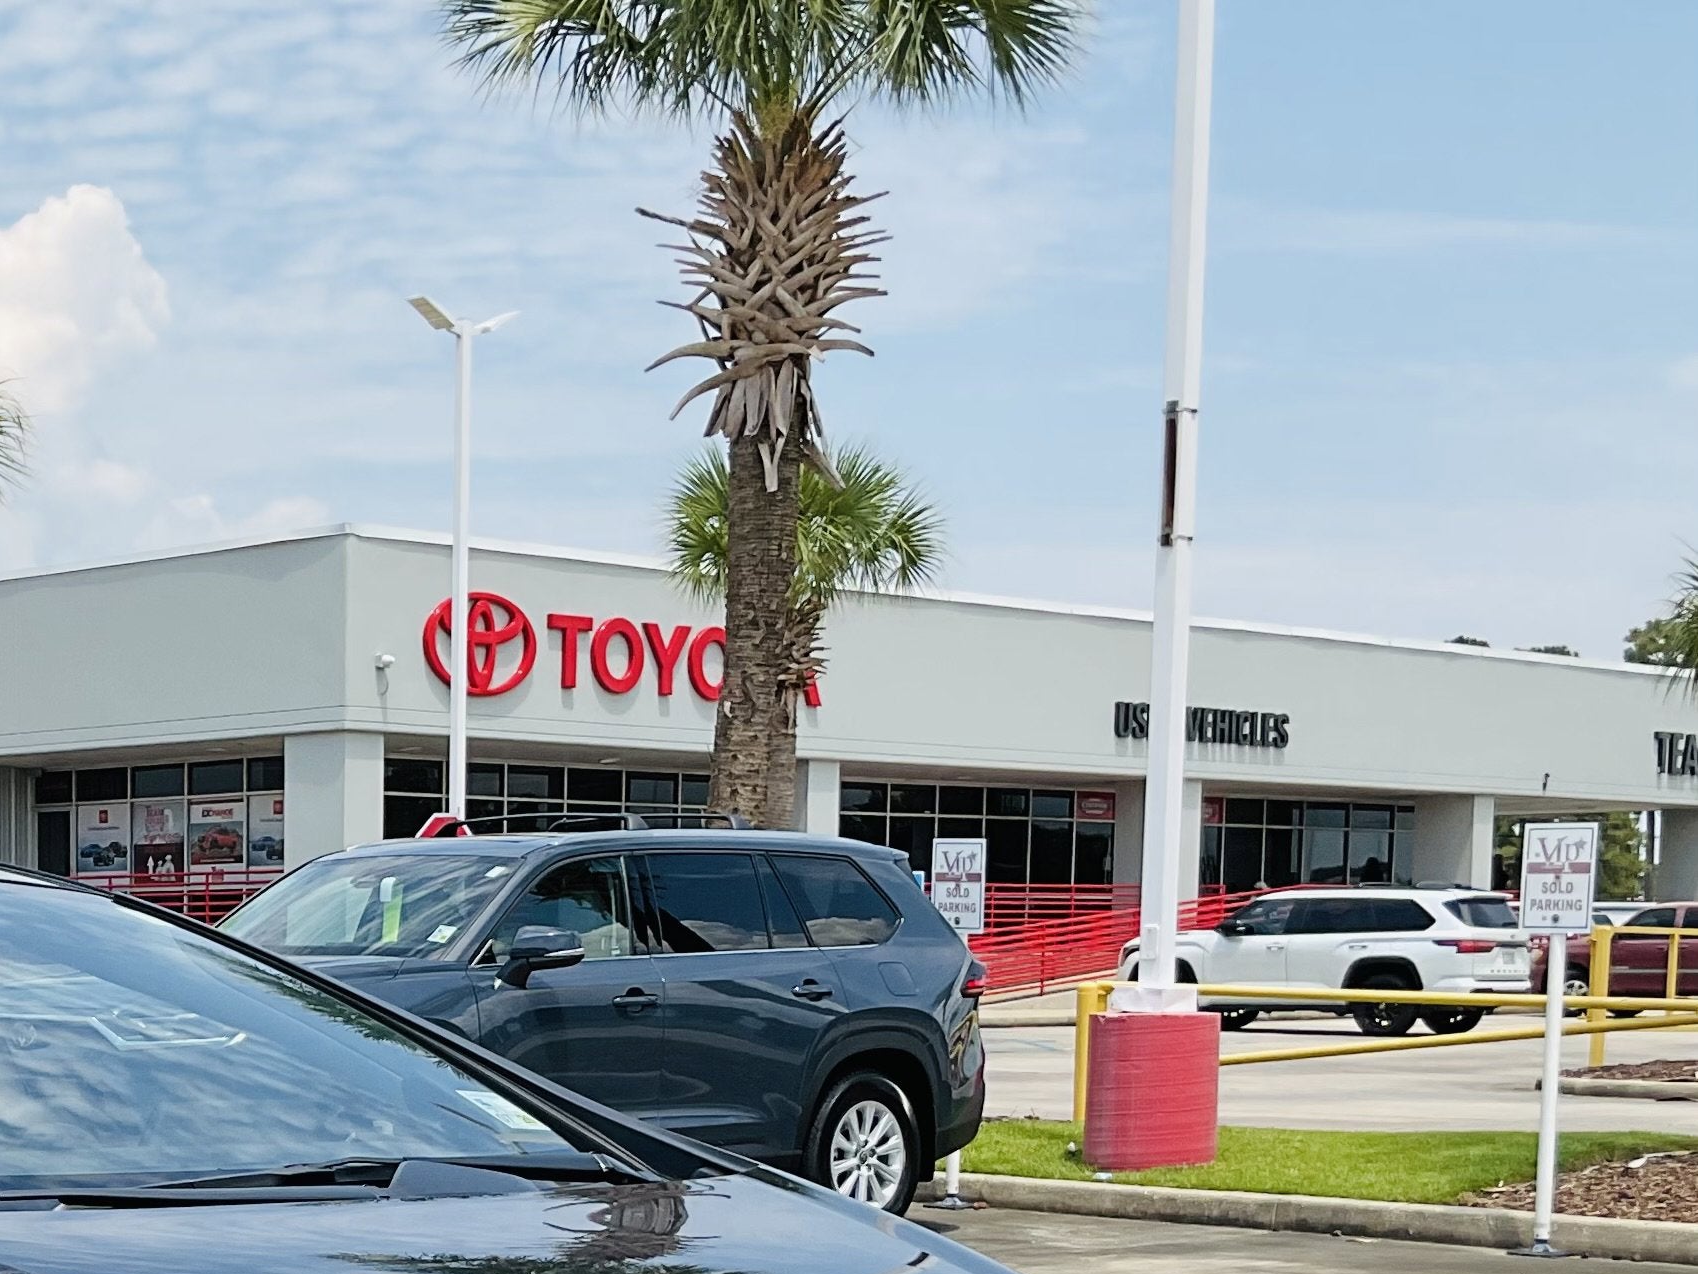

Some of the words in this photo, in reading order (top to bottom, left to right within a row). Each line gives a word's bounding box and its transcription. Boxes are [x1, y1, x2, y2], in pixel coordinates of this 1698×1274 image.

[546, 613, 822, 707] TOYO
[1114, 701, 1150, 740] US
[1185, 706, 1290, 749] VEHICLES
[1654, 731, 1698, 776] TEA
[946, 887, 970, 898] SOLD
[1541, 881, 1574, 894] SOLD
[938, 902, 977, 913] PARKING
[1529, 899, 1583, 912] PARKING
